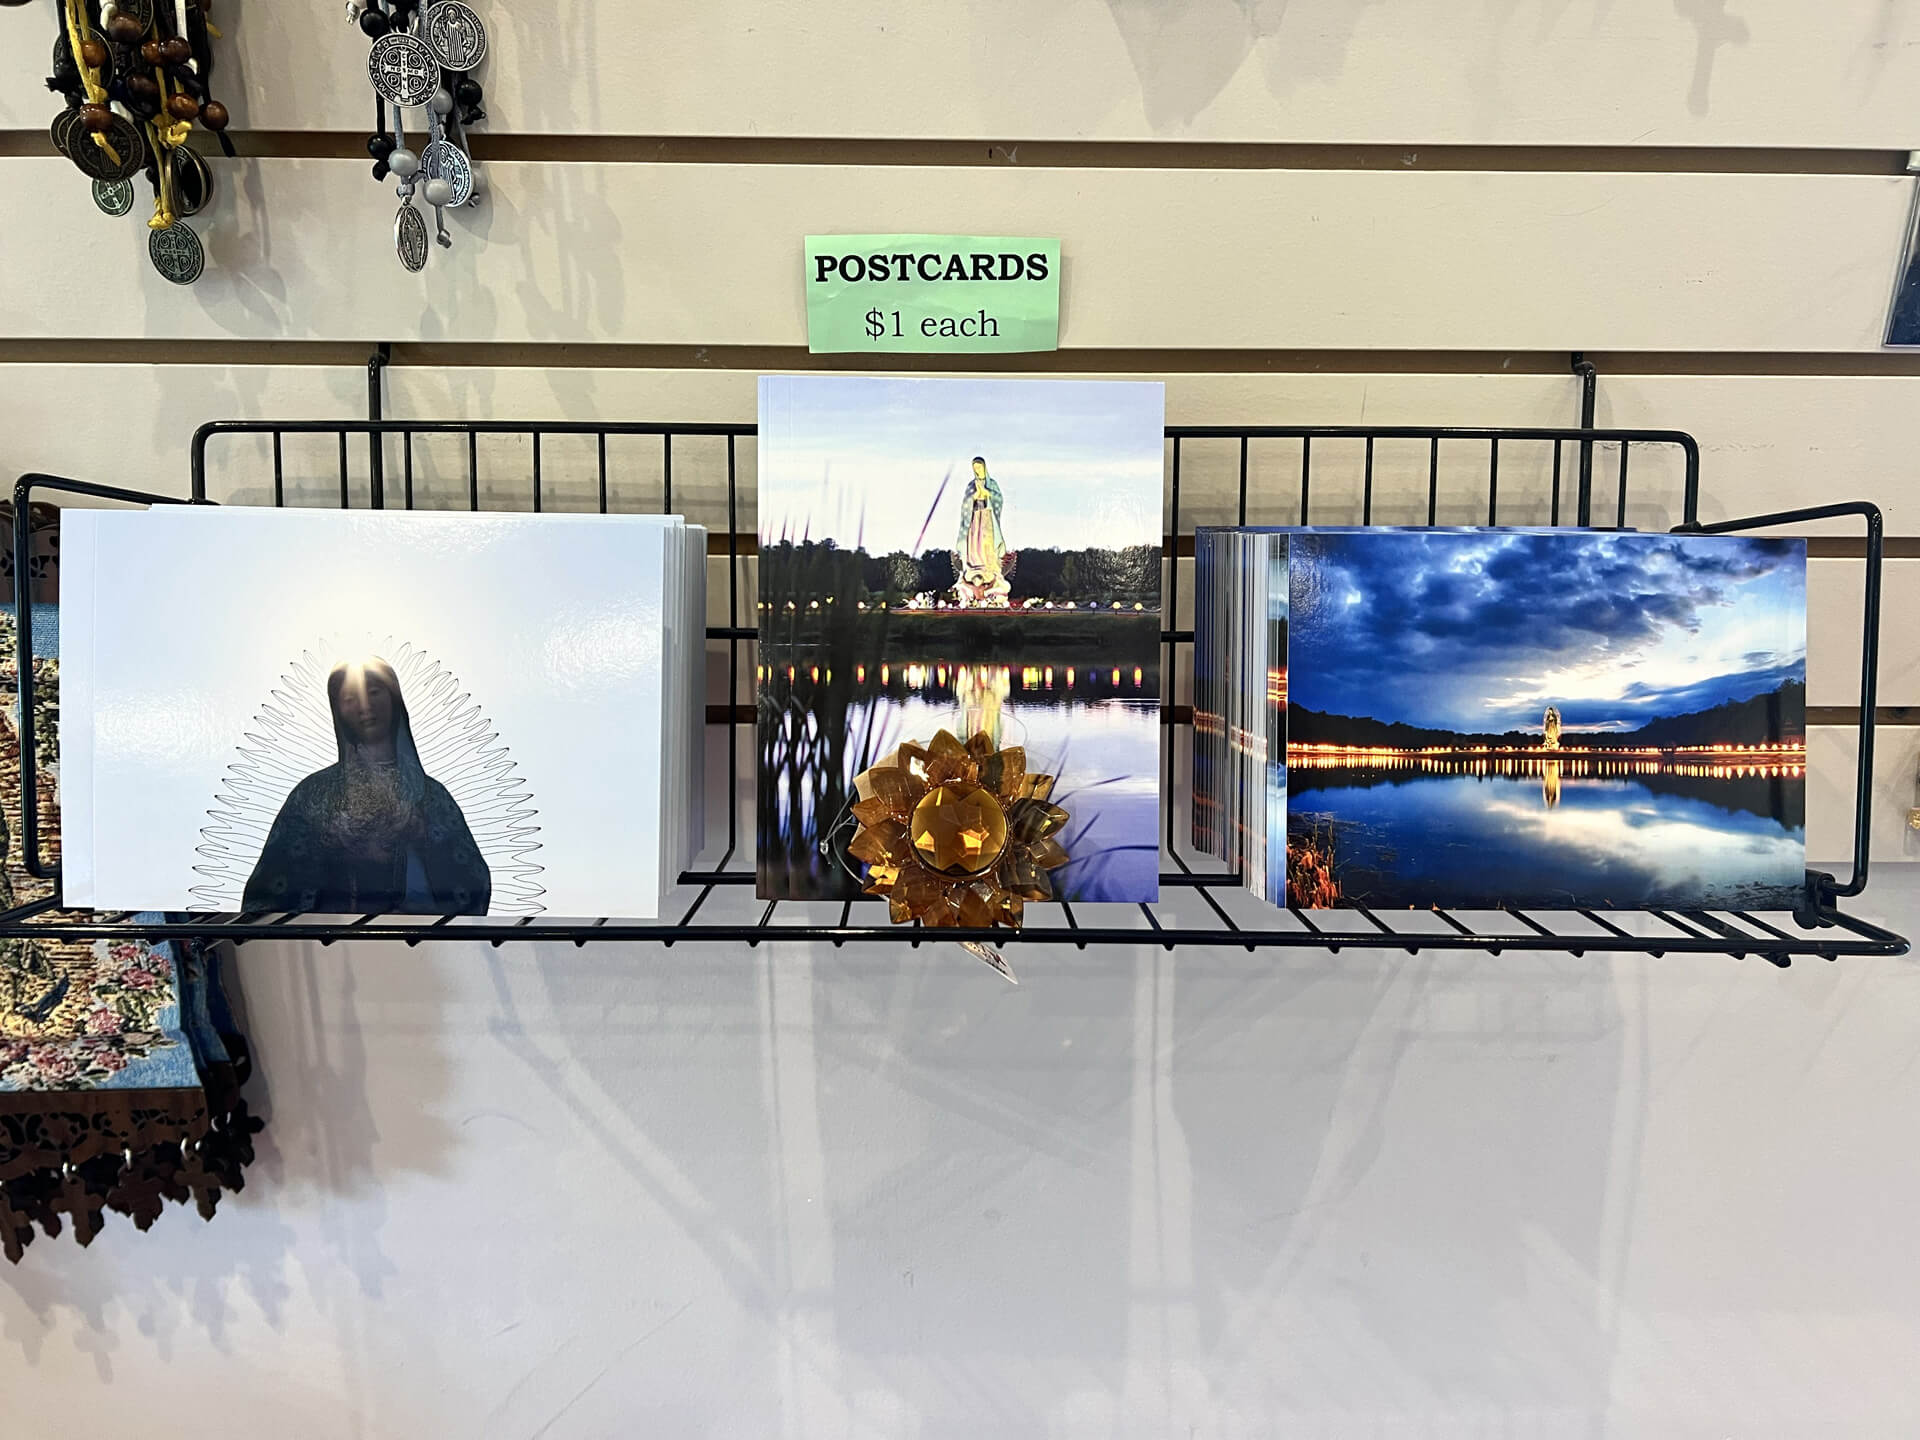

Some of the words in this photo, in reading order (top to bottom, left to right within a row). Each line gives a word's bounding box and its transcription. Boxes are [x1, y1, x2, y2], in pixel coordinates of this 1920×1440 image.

[815, 254, 1049, 282] POSTCARDS
[865, 307, 905, 341] $1
[920, 310, 1000, 337] each
